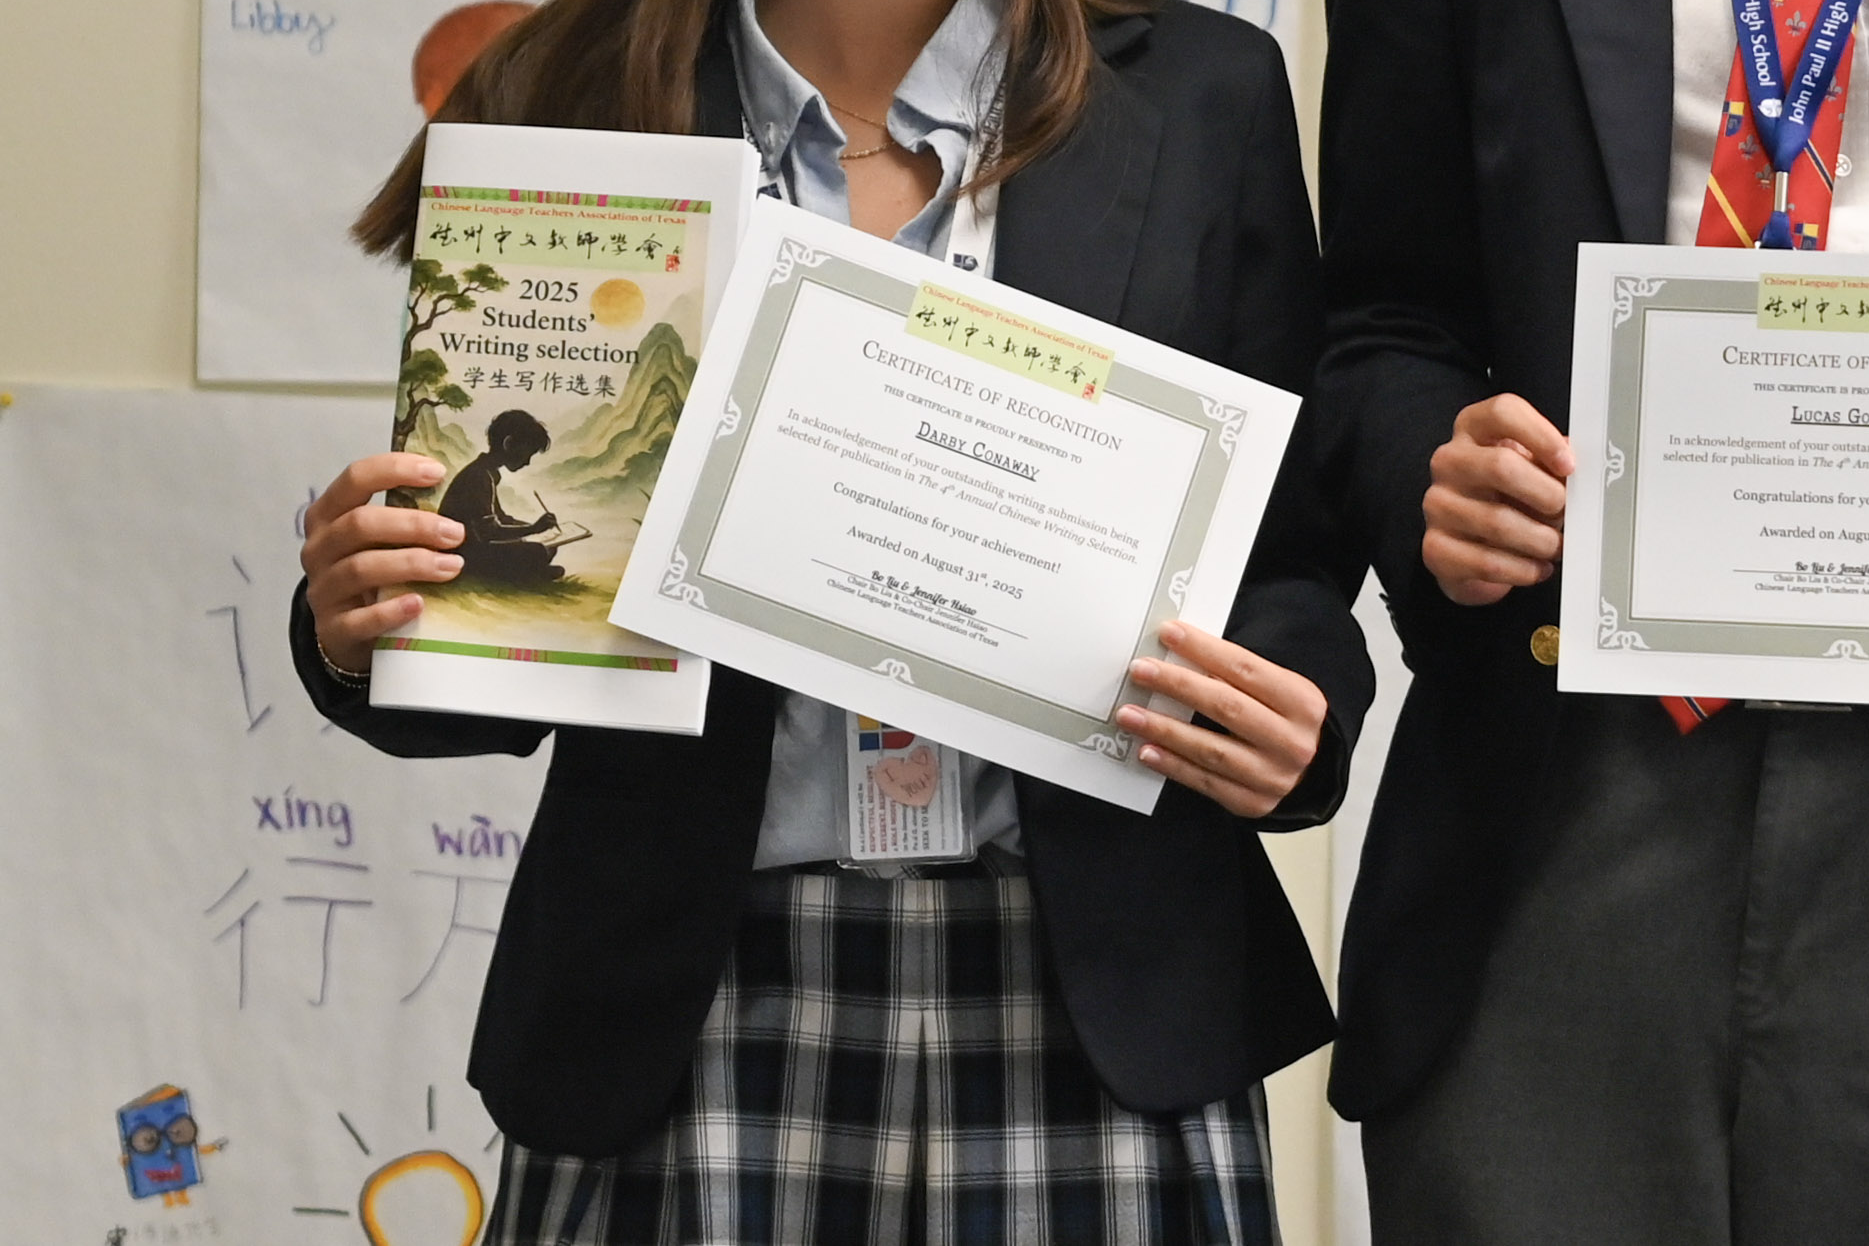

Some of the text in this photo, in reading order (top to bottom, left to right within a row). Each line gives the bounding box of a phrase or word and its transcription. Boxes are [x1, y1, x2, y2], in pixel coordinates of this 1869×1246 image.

[1823, 0, 1849, 37] High
[1750, 34, 1777, 87] School
[1815, 38, 1833, 52] II
[1802, 53, 1827, 92] Paul
[1788, 90, 1810, 125] John
[430, 201, 687, 225] Chinese Language Teachers Association of Texas
[519, 279, 579, 303] 2025
[440, 332, 641, 364] Writing selection
[463, 367, 617, 398] 学生写作选集
[776, 424, 823, 447] selected
[822, 438, 841, 454] for
[839, 448, 903, 477] publication
[903, 468, 916, 482] in
[917, 473, 939, 490] The
[954, 489, 999, 512] Annual
[998, 504, 1042, 528] Chinese
[1043, 519, 1086, 546] Writing
[787, 407, 1140, 550] In acknowledgement of your outstanding writing submission being
[1733, 488, 1835, 505] Congratulations
[1837, 492, 1857, 506] for
[833, 481, 1062, 574] Congratulations for your achievement!
[1759, 525, 1816, 539] Awarded
[1818, 530, 1835, 540] on
[846, 525, 902, 554] Awarded
[903, 547, 919, 560] on
[920, 552, 964, 577] August
[991, 579, 1024, 600] 2025
[204, 857, 373, 1011] 行
